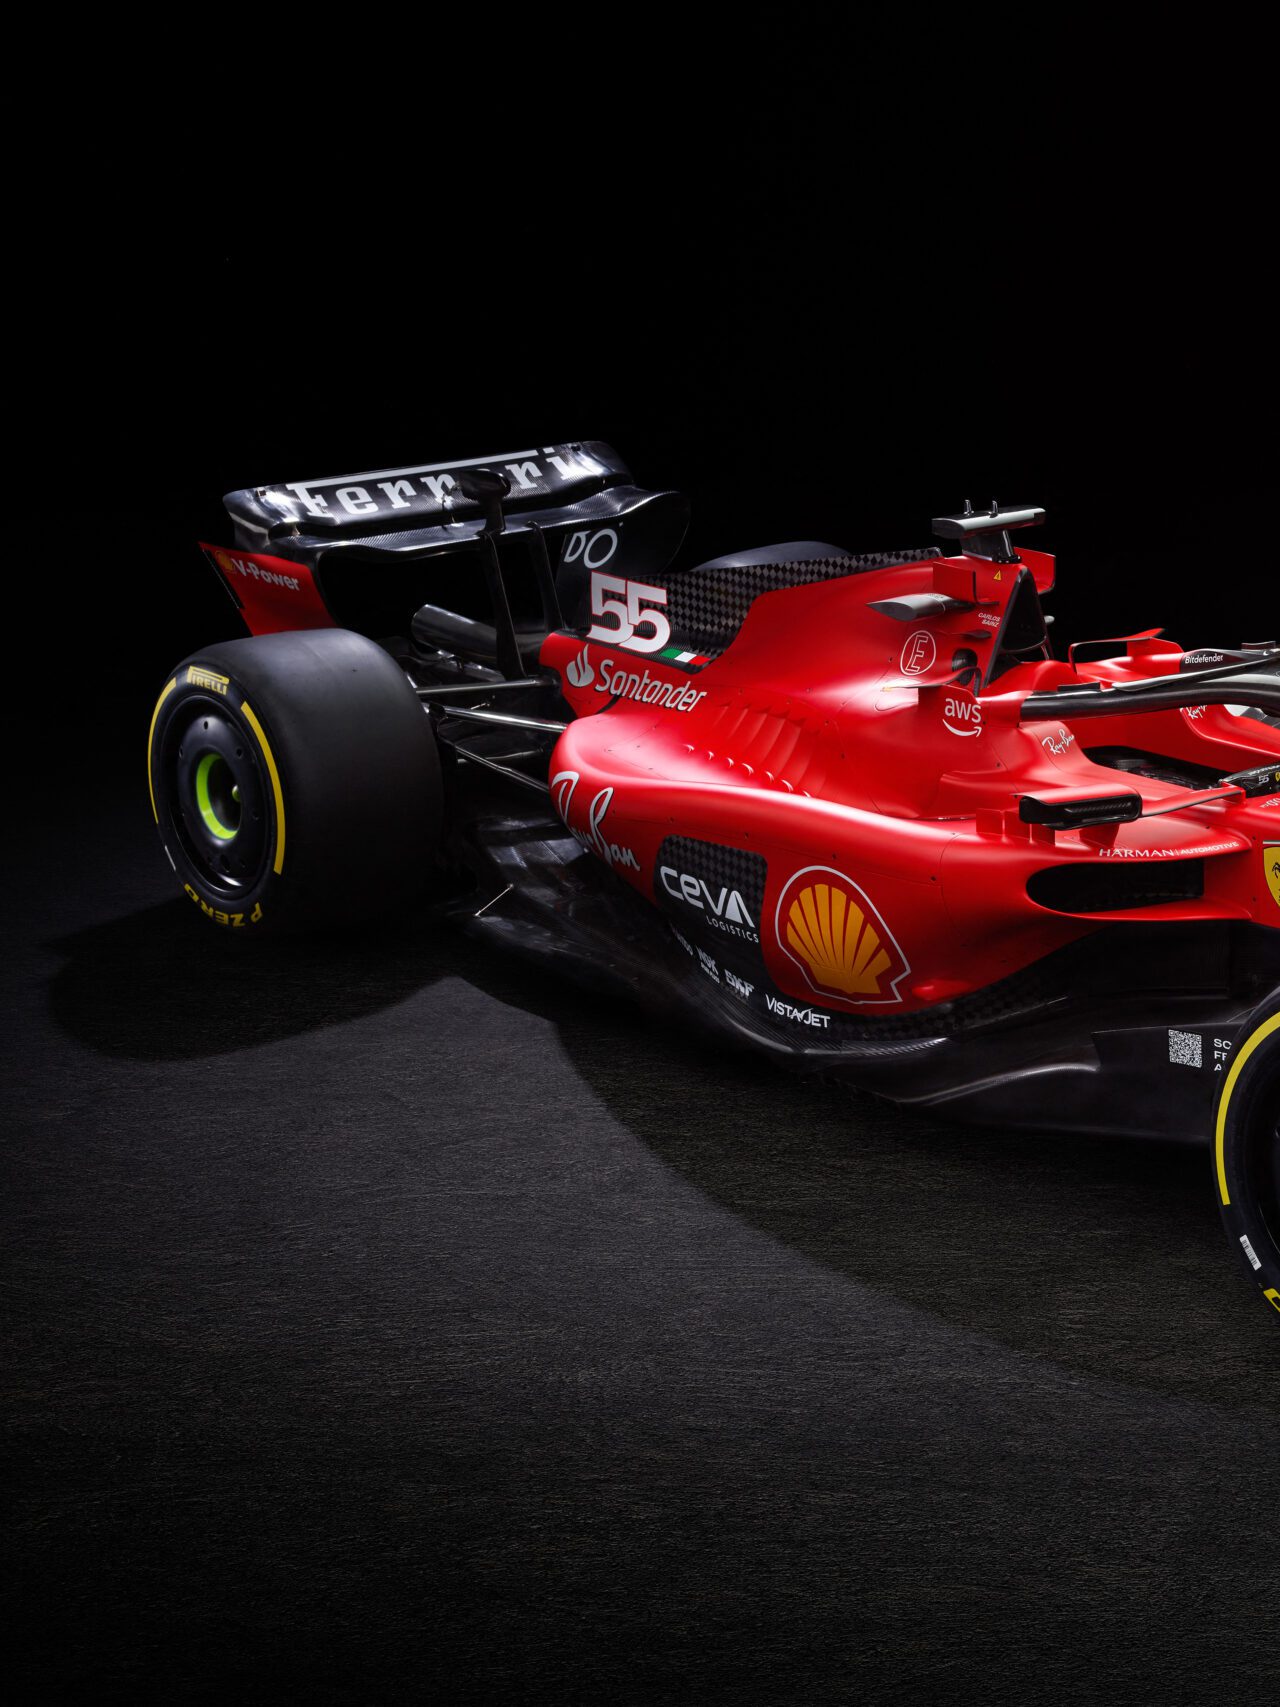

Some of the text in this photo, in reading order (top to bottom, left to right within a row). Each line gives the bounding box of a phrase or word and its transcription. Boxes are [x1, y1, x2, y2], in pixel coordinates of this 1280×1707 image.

[286, 447, 580, 518] Ferrri
[231, 558, 300, 591] V-Power
[586, 571, 671, 653] 55
[1184, 653, 1224, 664] Bitdefender
[187, 665, 229, 695] PIRELLI
[595, 659, 707, 712] Santander
[944, 697, 982, 723] aws
[1099, 841, 1240, 858] HARMAN AUTOMOTIVE
[183, 882, 264, 927] P ZERO
[705, 914, 760, 944] LOGISTICS
